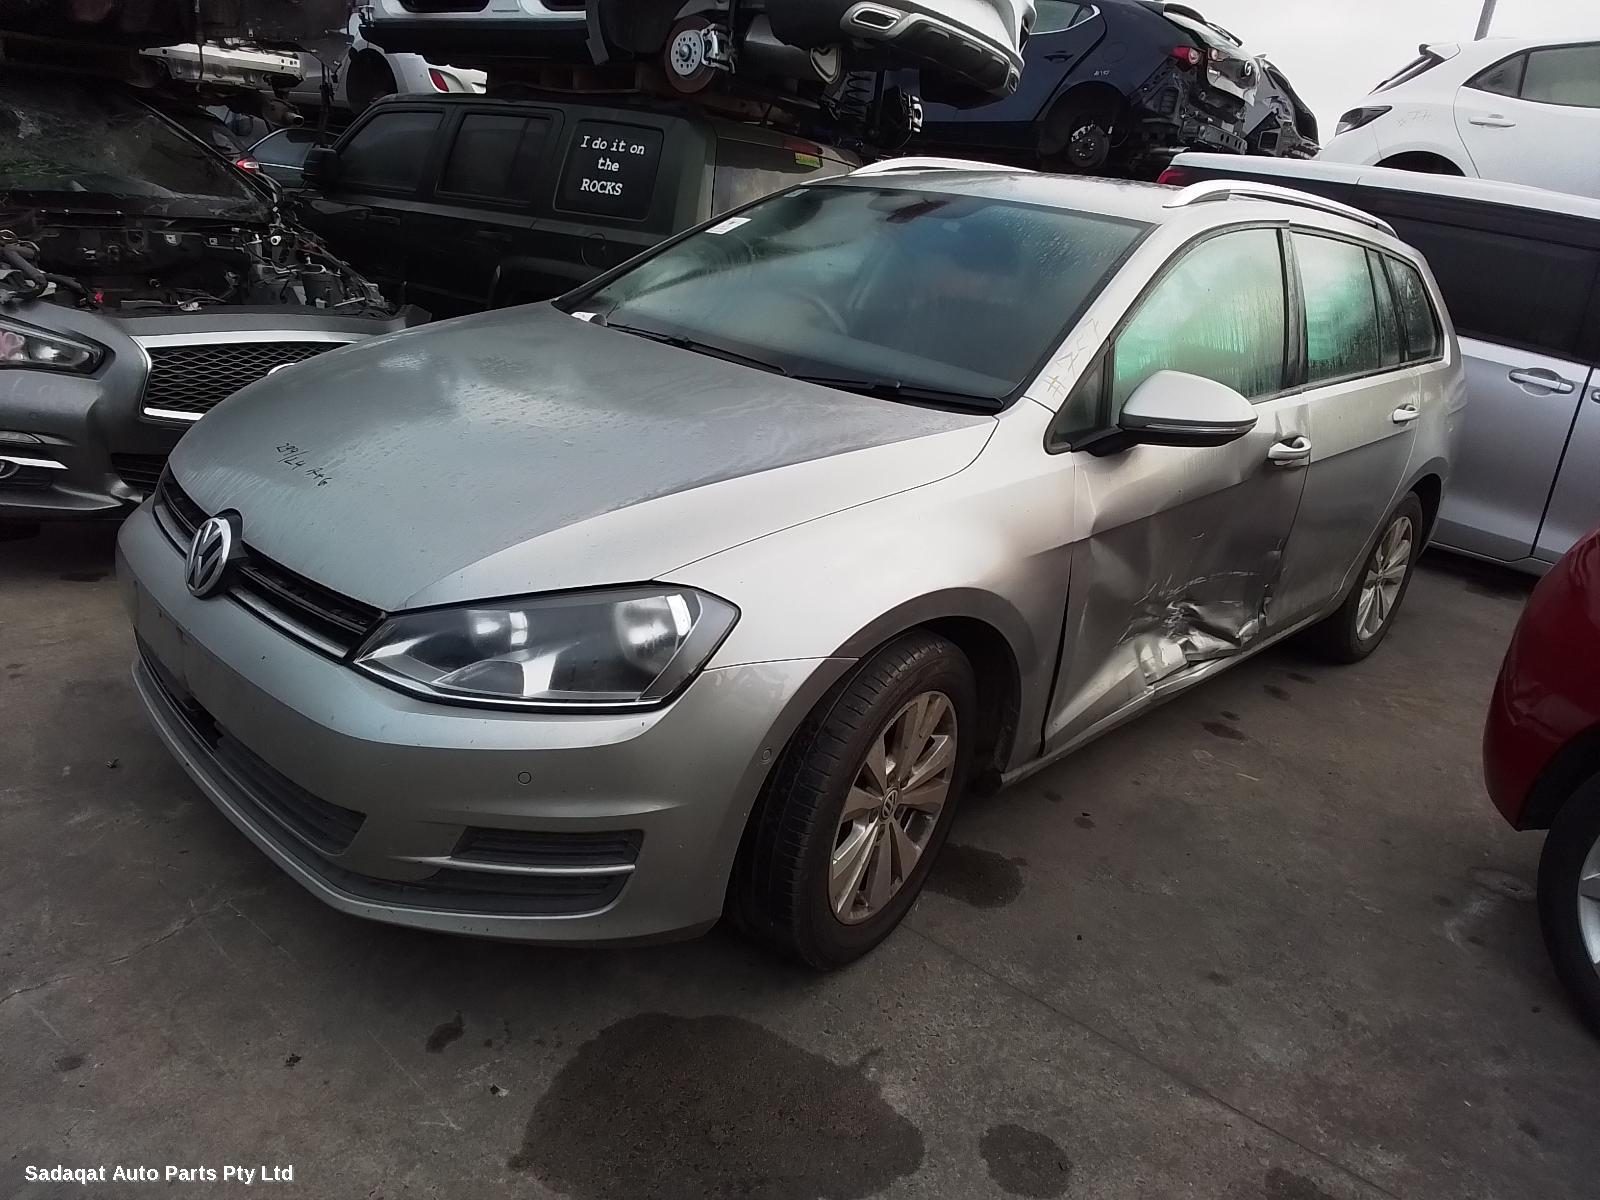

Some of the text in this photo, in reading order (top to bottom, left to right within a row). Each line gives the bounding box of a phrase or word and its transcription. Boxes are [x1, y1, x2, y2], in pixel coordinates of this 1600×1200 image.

[580, 135, 646, 156] I do it on
[597, 157, 620, 172] the
[580, 178, 623, 196] ROCKS
